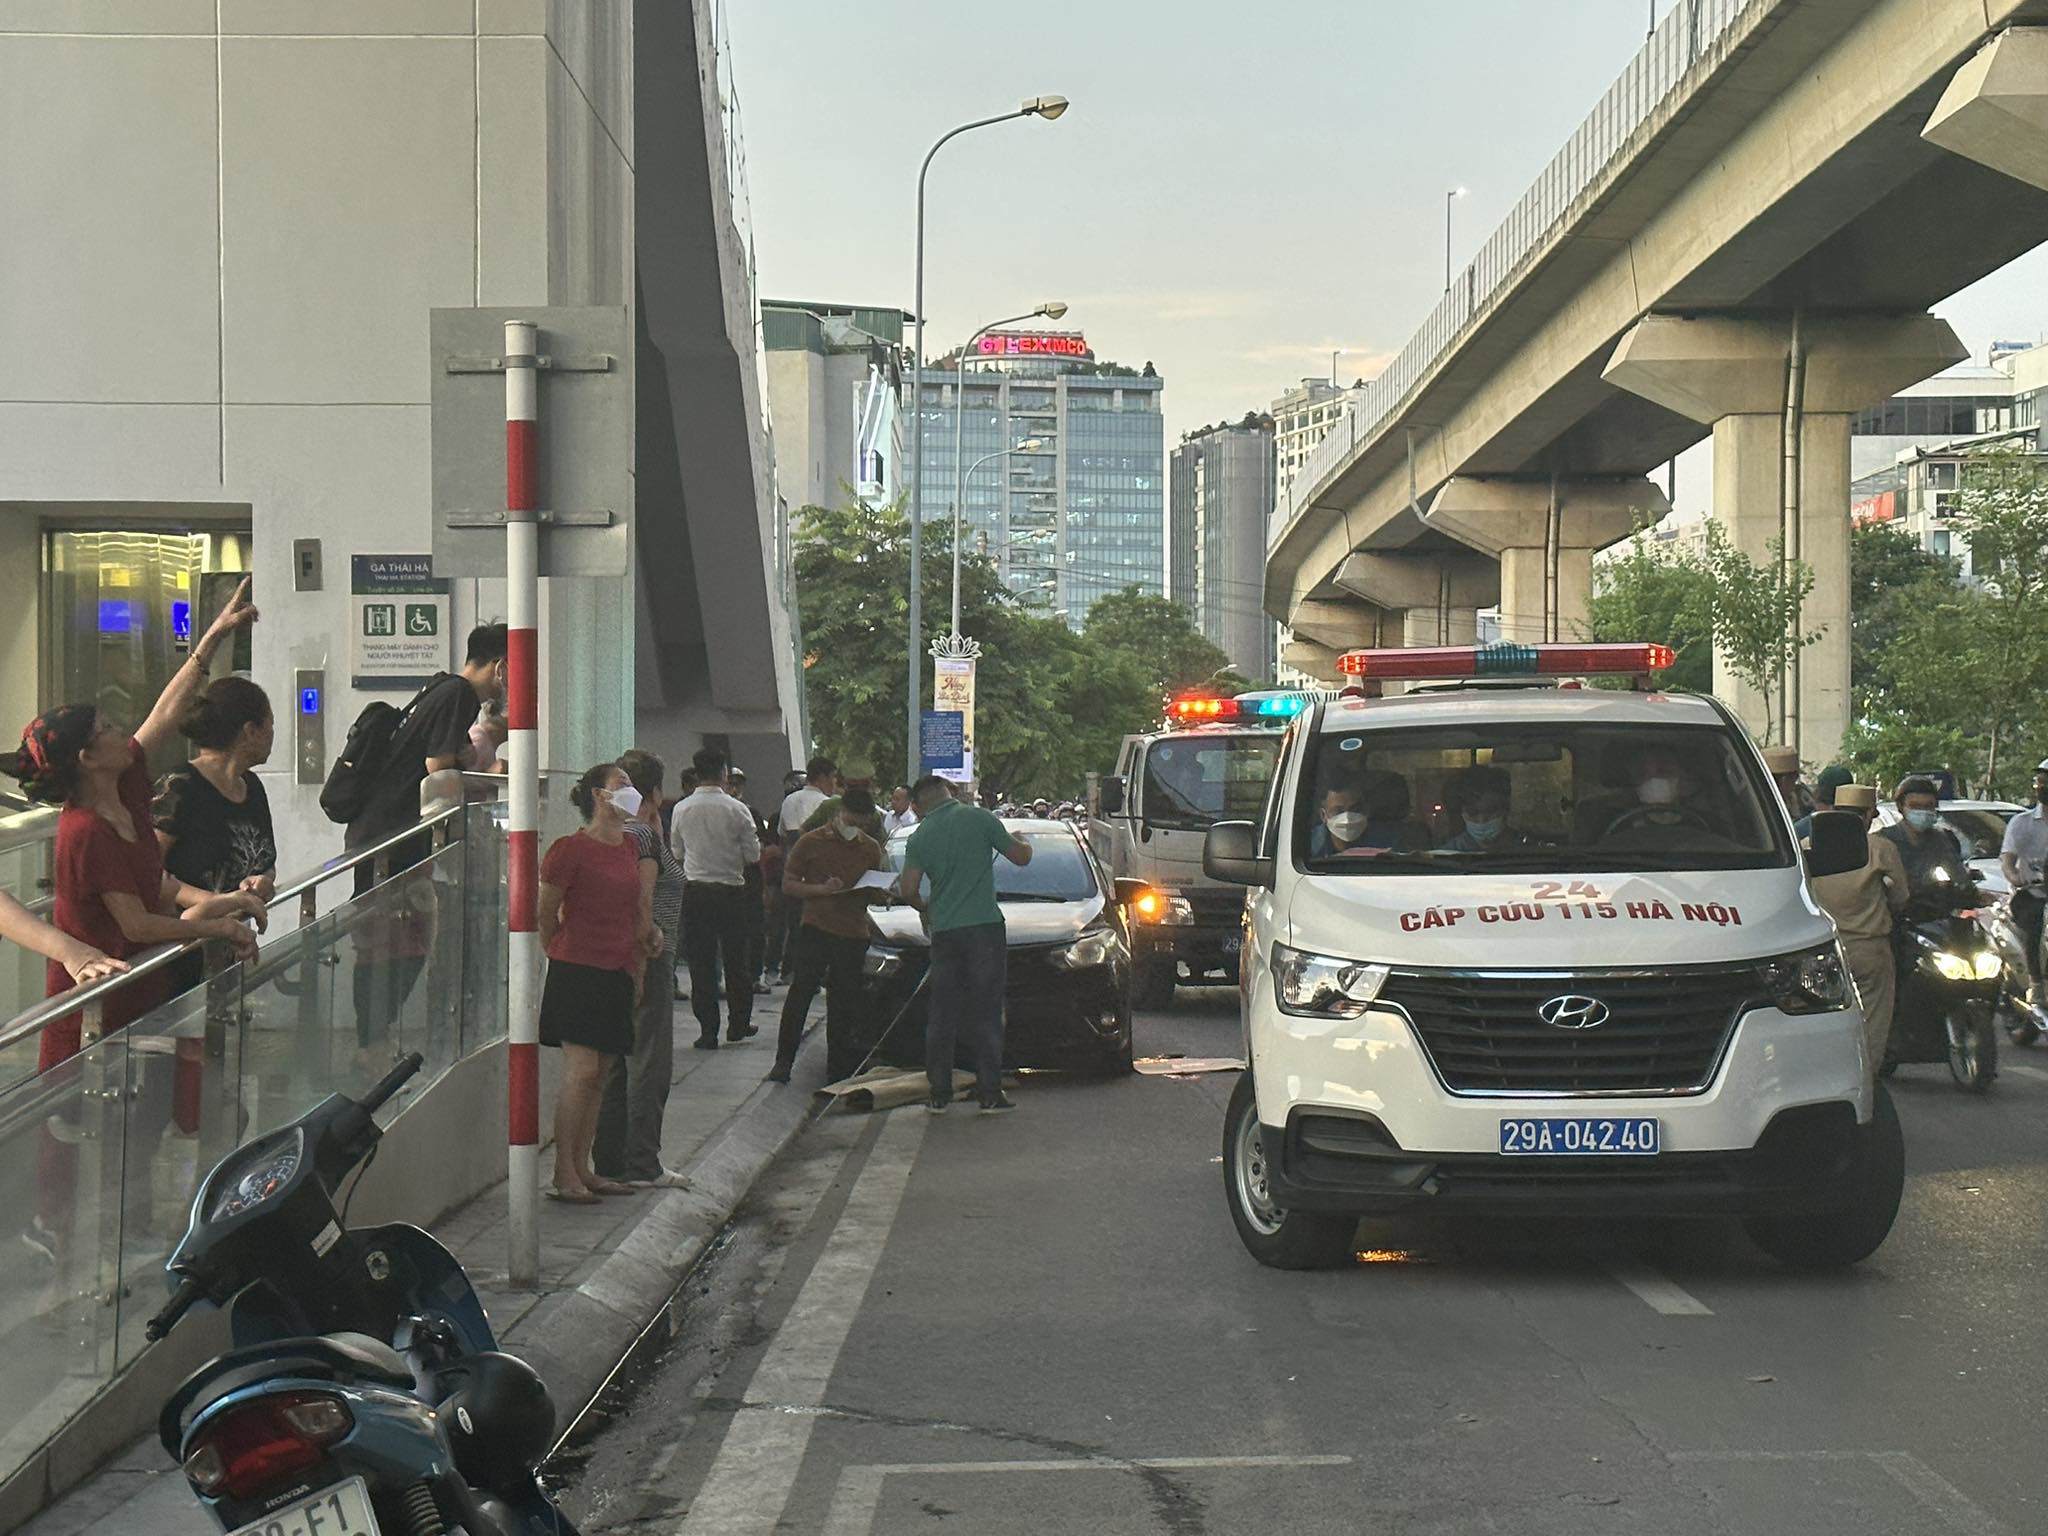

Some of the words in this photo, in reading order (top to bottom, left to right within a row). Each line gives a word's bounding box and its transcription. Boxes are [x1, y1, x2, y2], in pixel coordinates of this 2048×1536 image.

[370, 563, 386, 572] GA
[1529, 880, 1602, 900] 24
[1398, 904, 1466, 933] CẤP
[1477, 900, 1545, 924] CỨU
[1554, 901, 1618, 919] 115
[1625, 898, 1673, 920] HÀ
[1681, 901, 1743, 927] NỘI
[1503, 1121, 1654, 1151] 29A-042.40
[264, 1484, 312, 1509] HONDA
